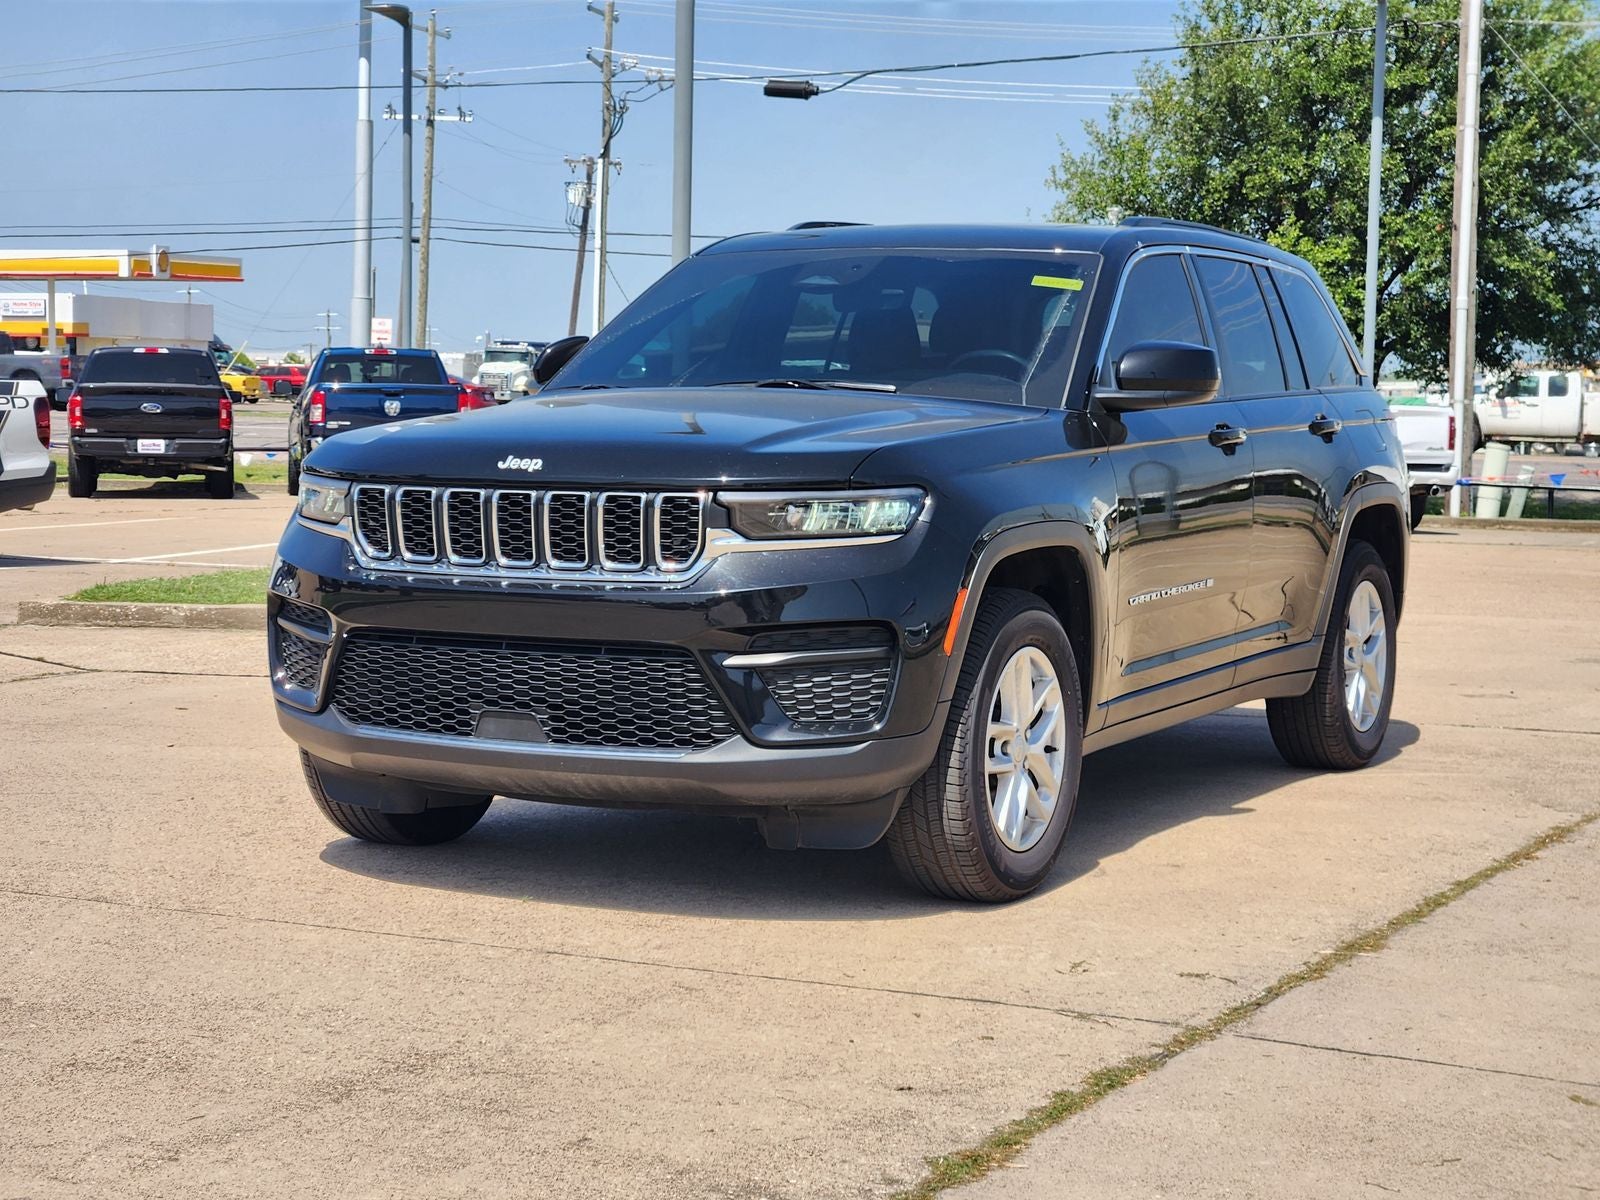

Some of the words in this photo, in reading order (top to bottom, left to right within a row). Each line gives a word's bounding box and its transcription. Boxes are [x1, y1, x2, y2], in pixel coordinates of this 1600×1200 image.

[497, 455, 543, 472] Jeep
[1128, 591, 1161, 606] GRAND
[1161, 580, 1207, 598] CHEROKEE
